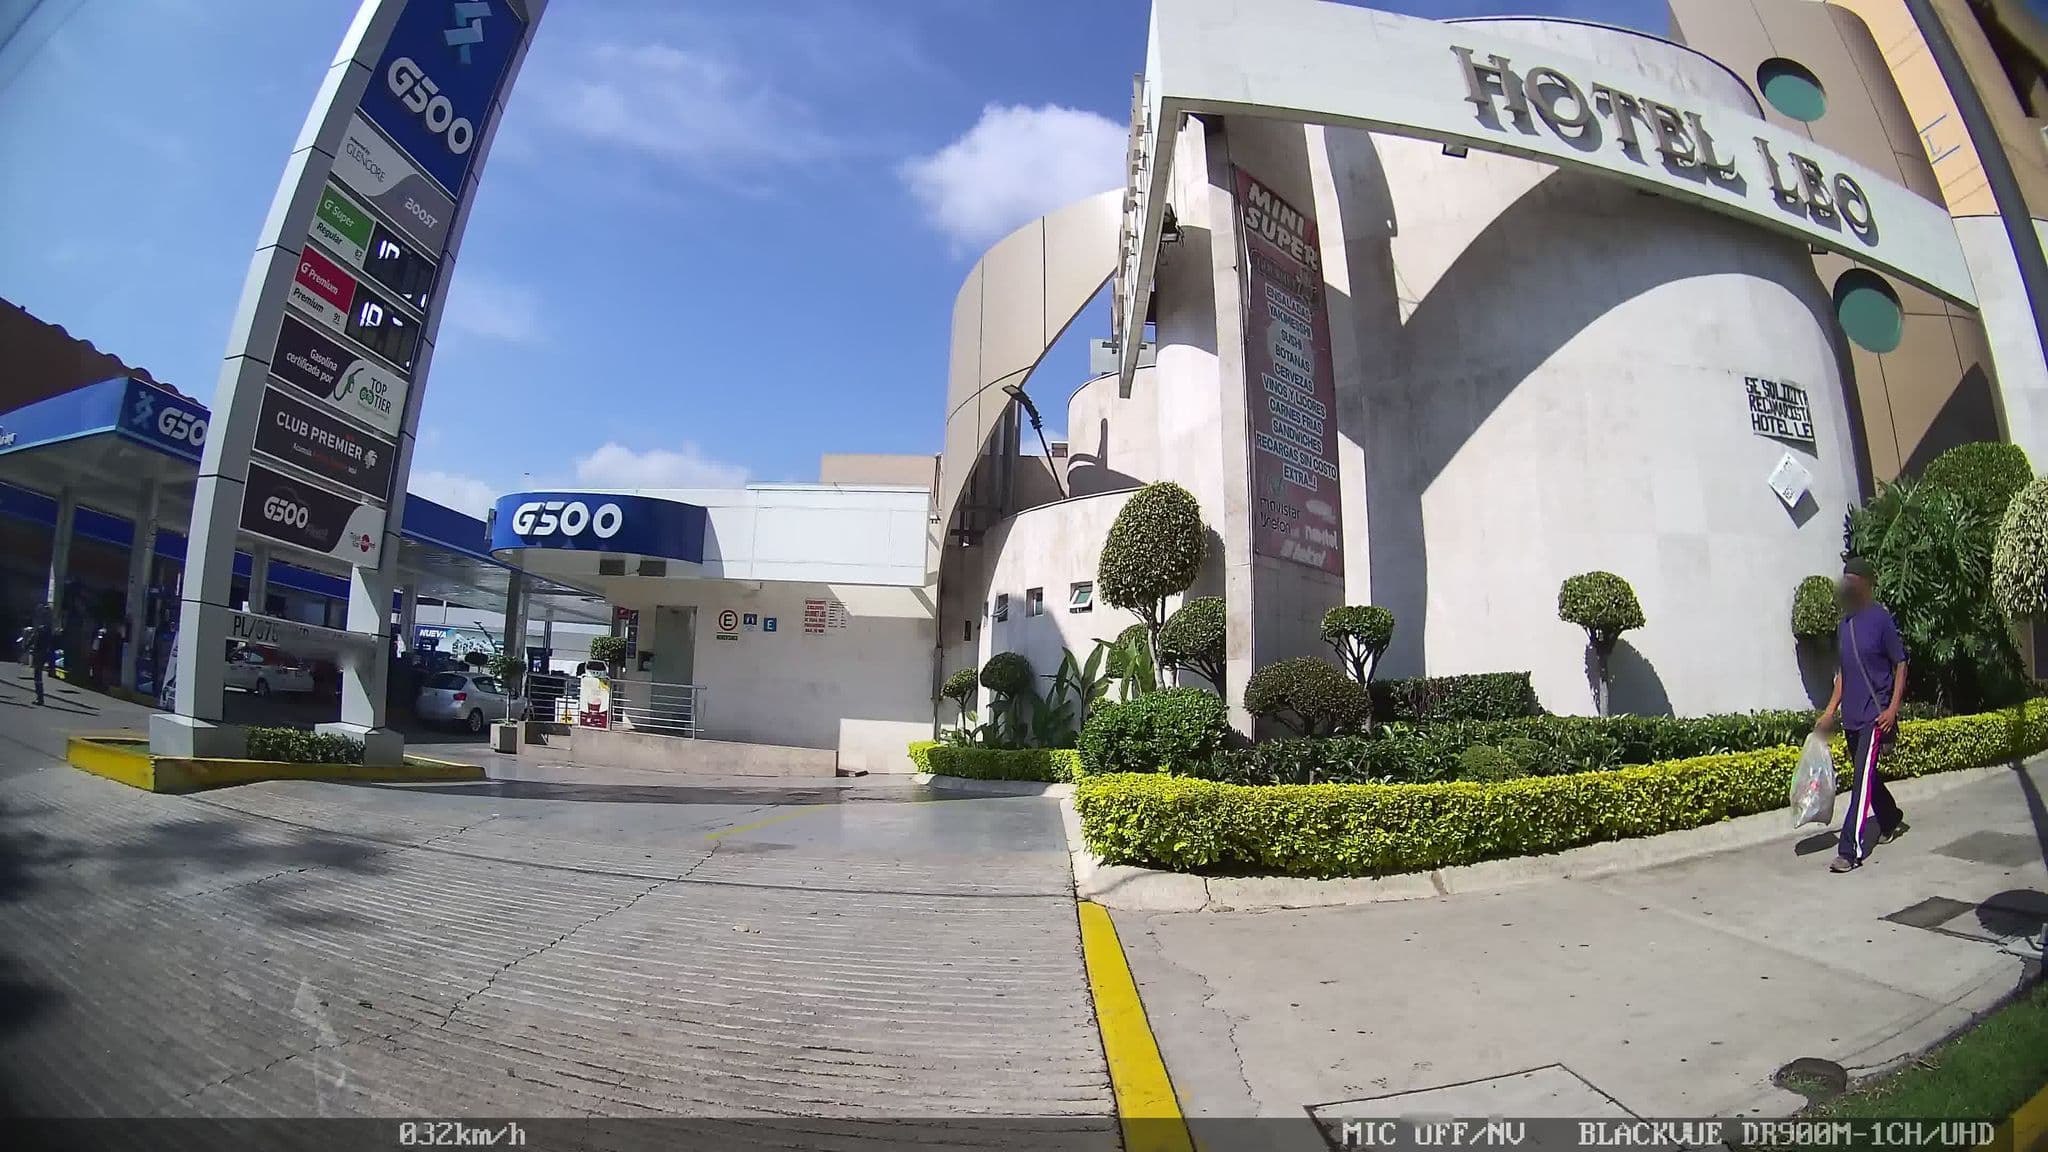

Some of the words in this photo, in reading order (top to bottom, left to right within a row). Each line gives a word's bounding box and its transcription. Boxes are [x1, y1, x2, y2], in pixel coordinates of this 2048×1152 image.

[388, 57, 473, 155] G500
[1449, 45, 1738, 185] HOTEL
[1752, 136, 1873, 237] LEO
[345, 143, 387, 183] GLENCORE
[324, 199, 333, 211] G
[334, 205, 355, 228] Super
[404, 197, 438, 229] BOOST
[1249, 183, 1305, 236] MINI
[316, 222, 343, 246] Regular
[1245, 207, 1319, 270] SUPER
[300, 263, 311, 274] G
[308, 269, 339, 295] Premium
[293, 287, 324, 313] Premium
[1281, 329, 1303, 350] SUSHI
[286, 352, 320, 379] certificada
[320, 370, 334, 385] por
[310, 349, 337, 372] Gasolina
[1275, 344, 1311, 372] BOTANAS
[371, 377, 388, 394] TOP
[1274, 363, 1314, 392] CERVEZAS
[1745, 376, 1761, 395] SE
[374, 394, 392, 415] TIER
[1262, 374, 1288, 396] VINOS
[1288, 389, 1295, 401] Y
[1294, 391, 1326, 417] LICORES
[1269, 400, 1301, 423] CARNES
[1301, 413, 1323, 434] FRIAS
[1751, 413, 1792, 433] HOTEL
[276, 411, 309, 438] CLUB
[310, 425, 363, 461] PREMIER
[1273, 420, 1322, 453] SANDWICHES
[1257, 434, 1299, 464] RECARGAS
[1299, 452, 1312, 470] SIN
[1313, 459, 1337, 479] COSTO
[263, 496, 310, 529] G500
[512, 501, 623, 539] G500
[419, 629, 448, 638] NUEVA
